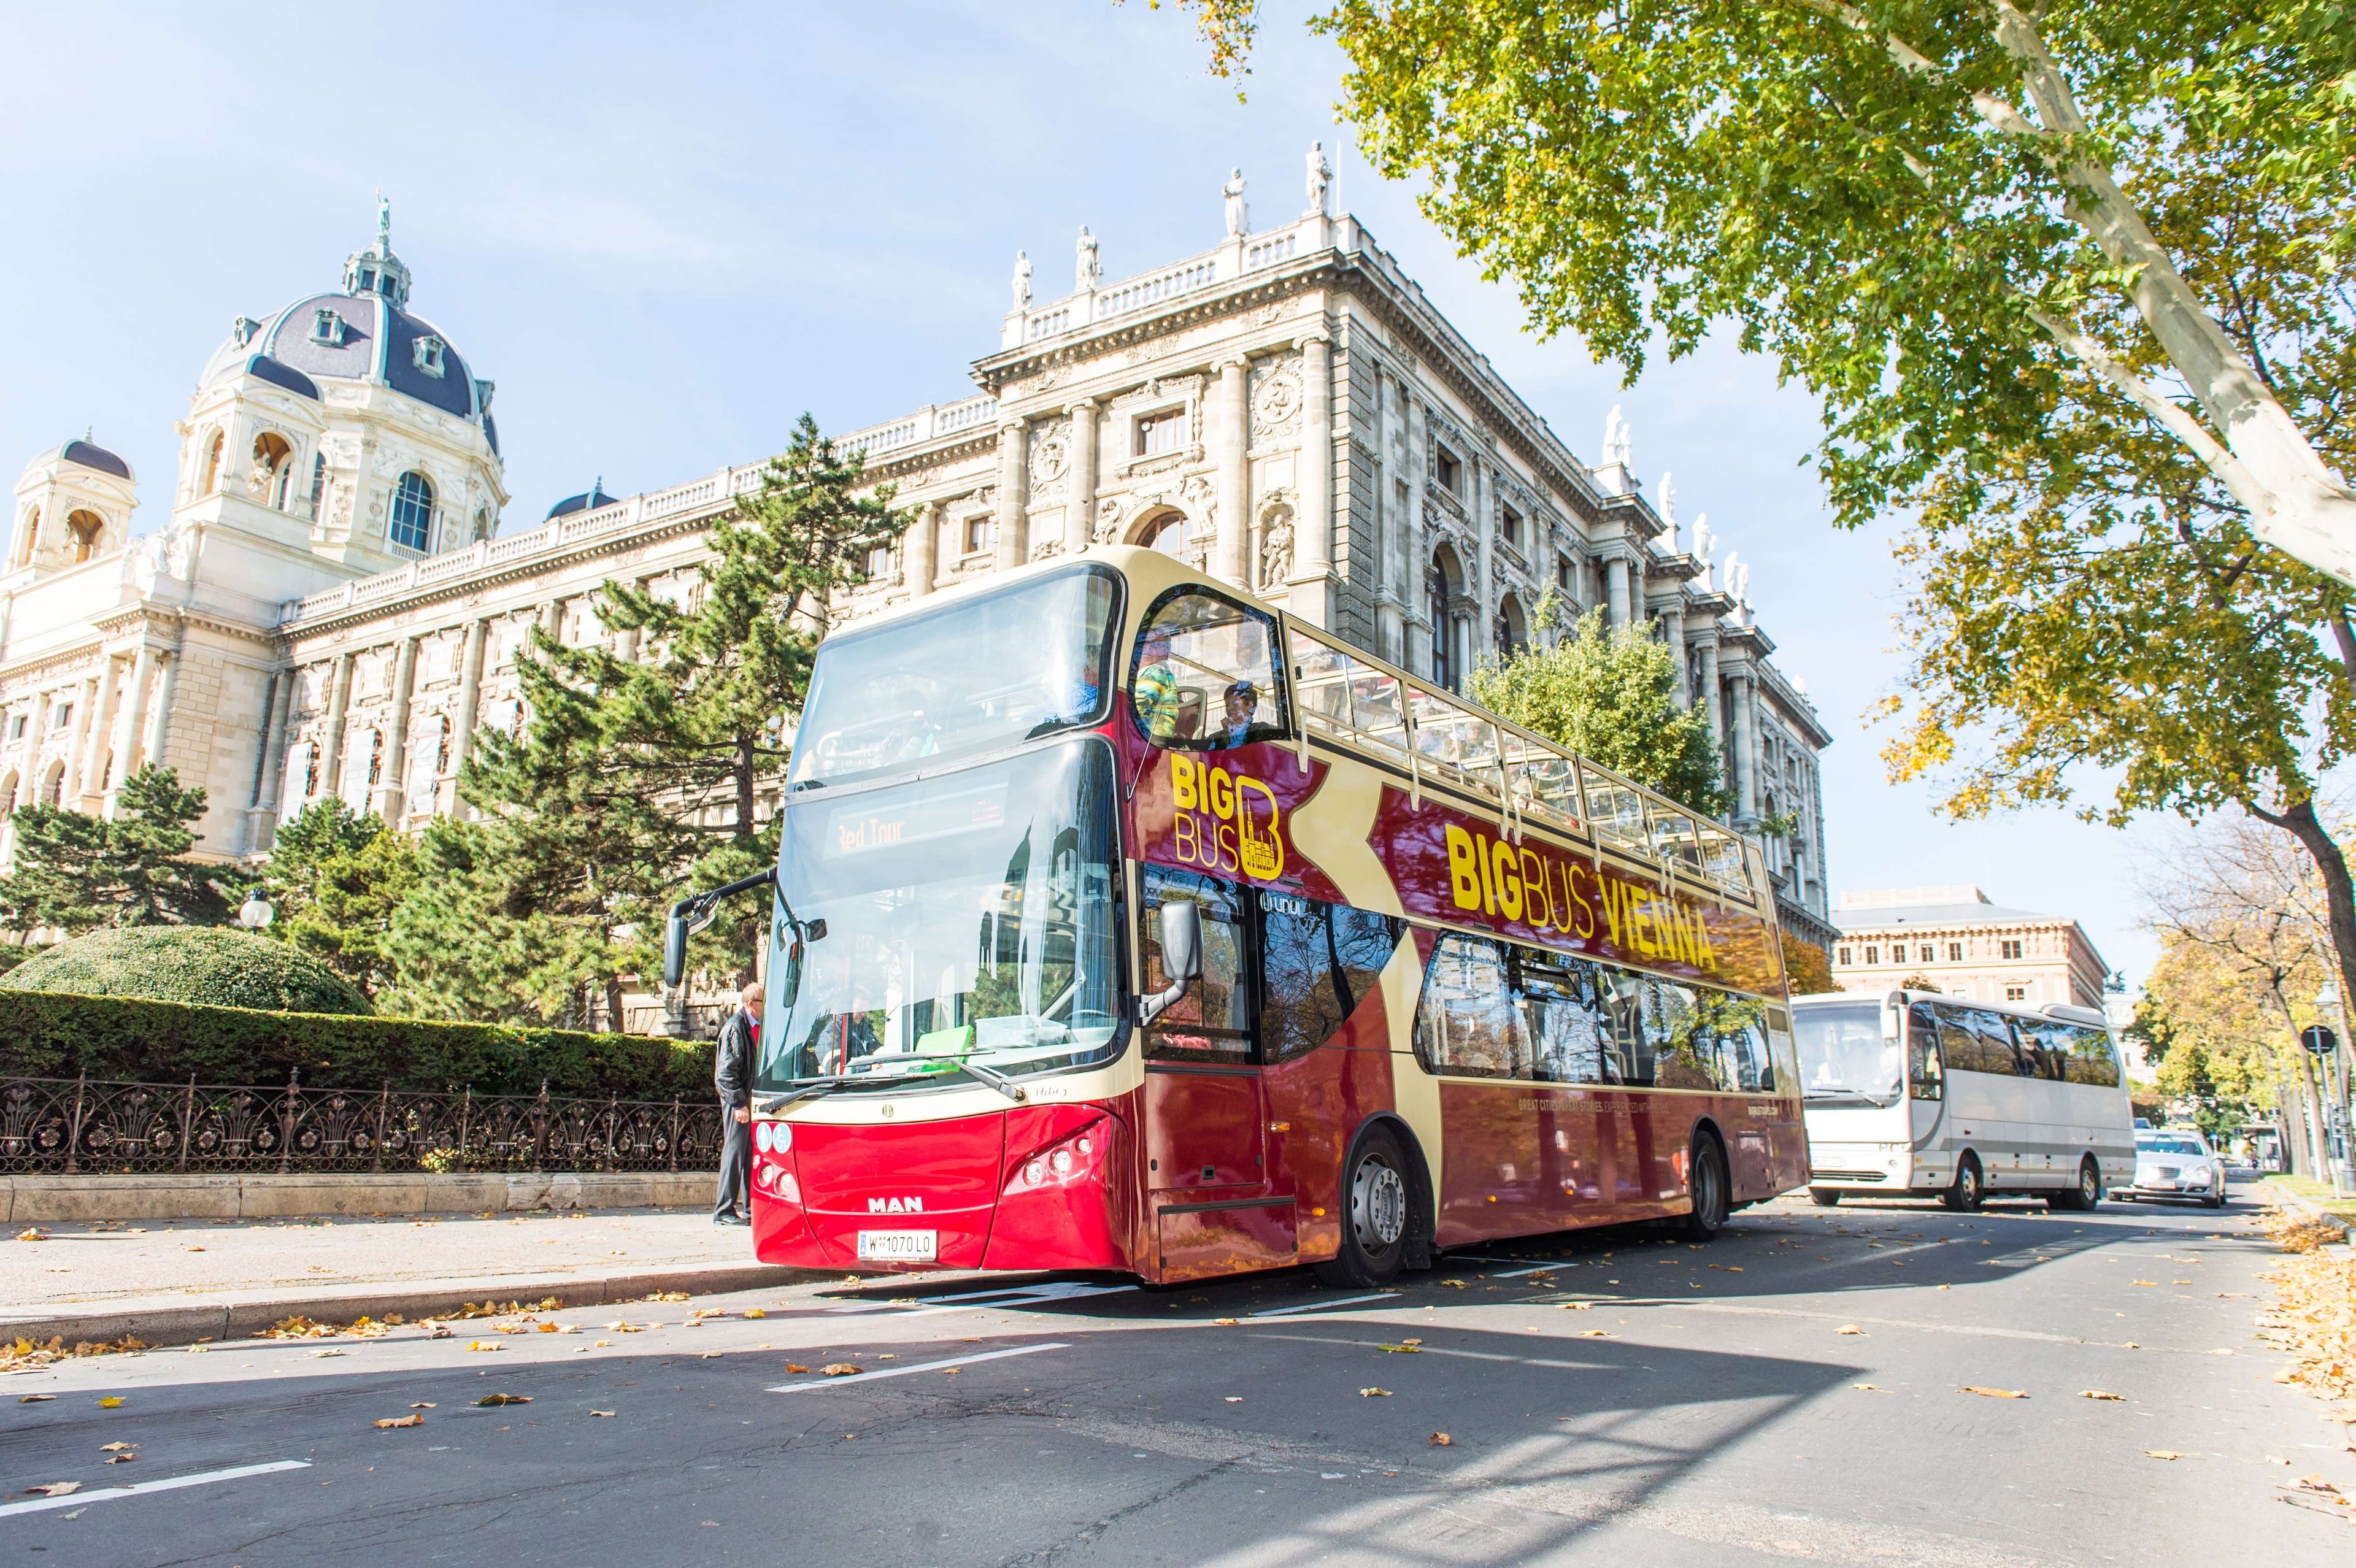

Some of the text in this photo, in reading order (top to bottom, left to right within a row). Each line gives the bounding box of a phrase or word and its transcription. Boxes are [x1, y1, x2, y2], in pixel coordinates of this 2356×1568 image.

[1171, 753, 1234, 820] BIG
[1175, 812, 1239, 872] BUS
[1597, 874, 1715, 970] VIENNA
[1519, 1099, 1538, 1111] GREAT
[868, 1196, 923, 1213] MAN
[869, 1236, 877, 1252] W
[887, 1236, 913, 1252] 1070
